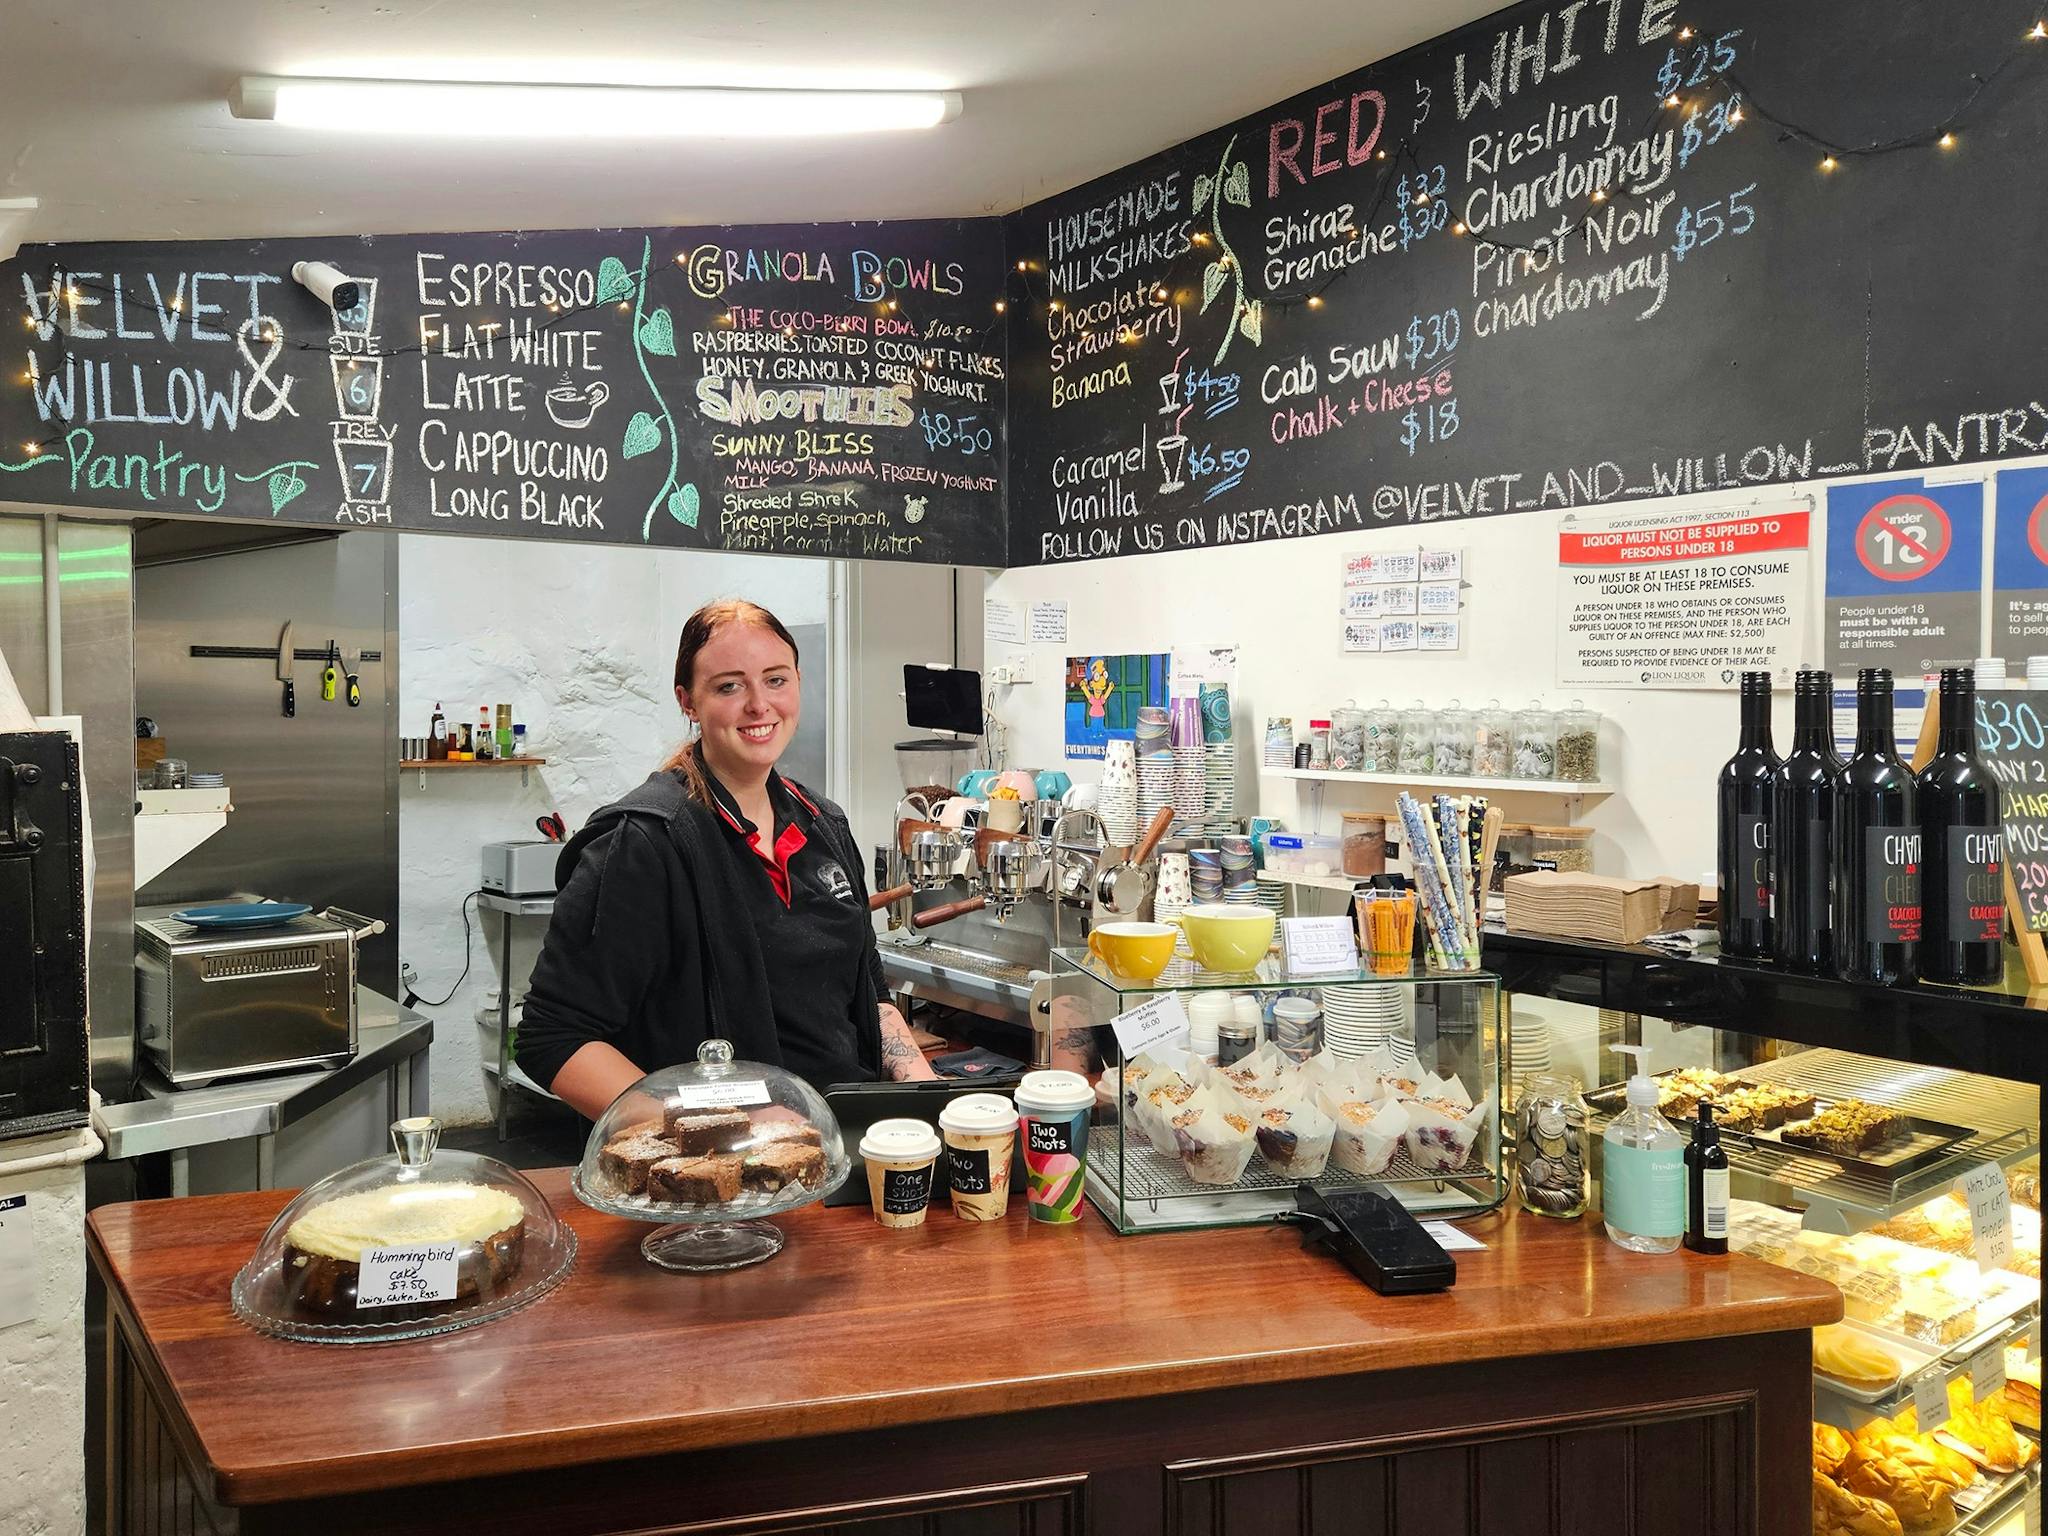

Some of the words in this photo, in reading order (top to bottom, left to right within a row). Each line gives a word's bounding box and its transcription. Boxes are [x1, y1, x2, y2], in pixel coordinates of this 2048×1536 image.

[1267, 89, 1387, 199] RED
[1453, 0, 1681, 121] WHITE
[1466, 95, 1618, 183] Riesling
[1654, 29, 1743, 98] $25
[1465, 129, 1675, 234] Chardonnay
[1048, 171, 1181, 260] HOUSEMADE
[1265, 203, 1354, 255] Shiraz
[1396, 164, 1447, 211] $32
[1264, 224, 1397, 291] Grenache
[1399, 199, 1448, 252] $30
[1472, 214, 1575, 297] Pinot
[1586, 190, 1676, 256] Noir
[1672, 182, 1758, 262] $55
[688, 244, 835, 299] GRANOLA
[852, 250, 964, 302] BOWLS
[1049, 220, 1192, 296] MILKSHAKES
[417, 251, 595, 308] ESPRESSO
[22, 271, 282, 341] VELVET
[730, 306, 763, 330] THE
[770, 309, 867, 334] COCO-BERRY
[1048, 279, 1164, 341] Chocolate
[328, 335, 382, 355] SUE
[419, 313, 502, 360] FLAT
[509, 317, 603, 371] WHITE
[804, 334, 868, 356] TOASTED
[875, 341, 945, 368] COCONUT
[1050, 303, 1182, 372] Strawberry
[28, 350, 240, 431] WILLOW
[237, 315, 299, 420] &
[773, 358, 856, 381] GRANOLA
[875, 362, 918, 387] GREEK
[1261, 355, 1317, 405] Cab
[1404, 307, 1461, 370] $30
[350, 375, 367, 404] 6
[422, 359, 527, 412] LATTE
[696, 374, 915, 428] SMOOTHIES
[1052, 361, 1132, 409] Banana
[1184, 366, 1241, 403] $4.50
[1271, 395, 1344, 444] Chalk
[1348, 397, 1360, 416] +
[1363, 368, 1453, 413] Cheese
[328, 421, 398, 440] TREV
[919, 407, 992, 455] $8.50
[1400, 398, 1460, 457] $18
[419, 419, 609, 482] CAPPUCCINO
[712, 433, 785, 457] SUNNY
[794, 429, 874, 462] BLISS
[1052, 423, 1146, 488] Caramel
[1187, 443, 1251, 480] $6.50
[65, 428, 226, 512] Pantry
[353, 464, 377, 493] 7
[724, 475, 769, 490] MILK
[881, 464, 937, 484] FROZEN
[941, 472, 997, 492] YOGHURT
[335, 502, 392, 525] ASH
[430, 478, 509, 521] LONG
[520, 480, 605, 530] BLACK
[722, 491, 792, 514] Shreded
[1056, 479, 1139, 525] Vanilla
[1041, 527, 1122, 560] FOLLOW
[1134, 524, 1163, 551] US
[1176, 517, 1206, 545] ON
[1217, 493, 1363, 542] INSTAGRAM
[1582, 535, 1623, 548] LIQUOR
[1625, 531, 1656, 544] MUST
[1660, 529, 1685, 543] NOT
[1688, 528, 1702, 540] BE
[1706, 522, 1759, 538] SUPPLIED
[1762, 521, 1780, 533] TO
[1609, 520, 1633, 529] LIQUOR
[1634, 517, 1669, 528] LICENSING
[1670, 516, 1683, 524] ACT
[1705, 511, 1735, 521] SECTION
[1737, 510, 1750, 518] 113
[1621, 545, 1672, 560] PERSONS
[1675, 542, 1715, 555] UNDER
[1720, 541, 1735, 552] 18
[1874, 525, 1929, 565] 18
[1573, 575, 1595, 585] YOU
[1599, 573, 1626, 583] MUST
[1629, 571, 1641, 582] BE
[1644, 570, 1657, 581] AT
[1660, 569, 1690, 580] LEAST
[1695, 567, 1707, 578] 18
[1712, 567, 1726, 577] TO
[1730, 563, 1790, 576] CONSUME
[1601, 583, 1640, 595] LIQUOR
[1643, 582, 1661, 593] ON
[1664, 580, 1696, 592] THESE
[1699, 577, 1755, 590] PREMISES.
[1839, 617, 1869, 628] must
[1872, 616, 1888, 627] be
[1891, 615, 1918, 626] with
[1921, 616, 1929, 625] a
[1840, 605, 1875, 618] People
[1878, 605, 1908, 616] under
[1911, 603, 1924, 614] 18
[2009, 601, 2030, 611] It's
[2009, 613, 2021, 623] to
[2023, 613, 2043, 623] sell
[1839, 626, 1909, 639] responsible
[1912, 625, 1945, 637] adult
[1839, 640, 1850, 649] at
[1851, 639, 1864, 649] all
[1866, 638, 1897, 649] times.
[2009, 625, 2021, 635] to
[1674, 671, 1706, 681] LIQUOR
[1031, 1123, 1057, 1137] Two
[1031, 1136, 1066, 1150] Shots
[895, 1173, 923, 1186] One
[370, 1247, 455, 1271] Hummingbird
[388, 1279, 428, 1291] $7.50
